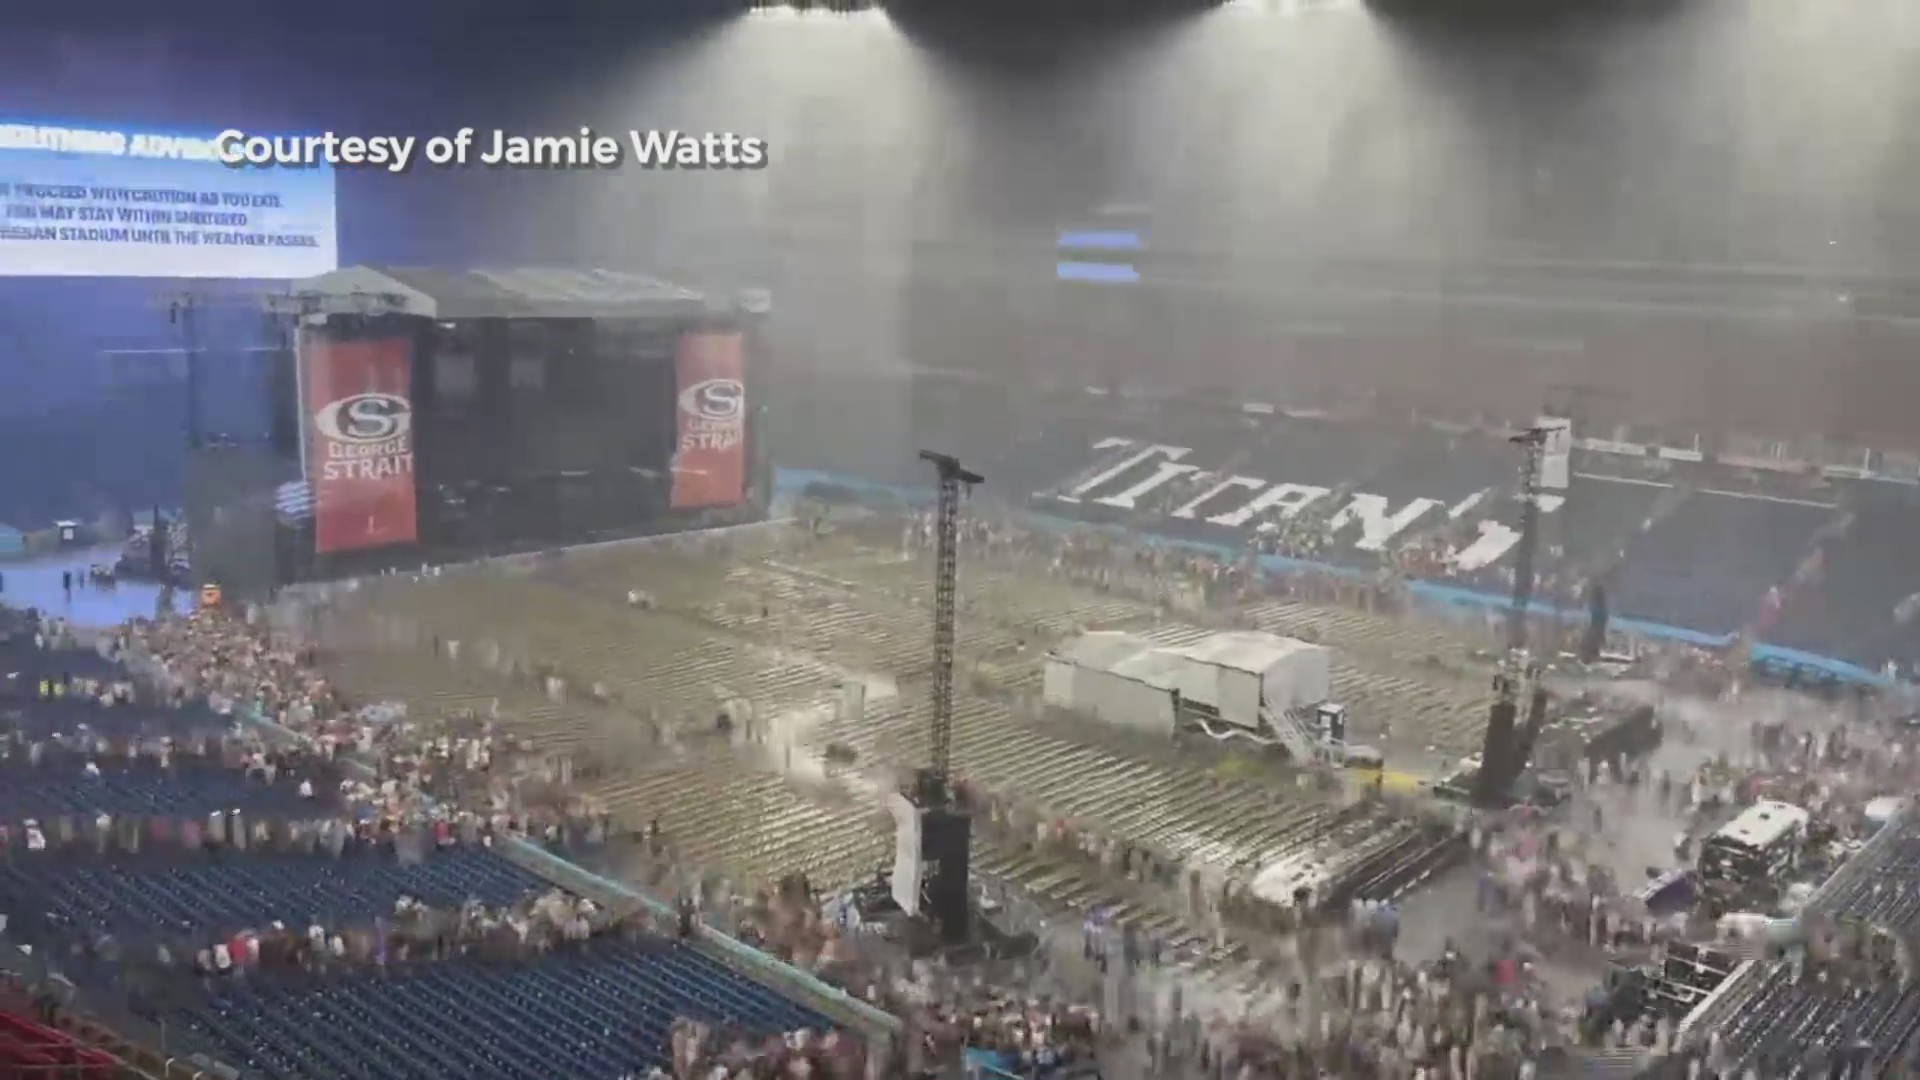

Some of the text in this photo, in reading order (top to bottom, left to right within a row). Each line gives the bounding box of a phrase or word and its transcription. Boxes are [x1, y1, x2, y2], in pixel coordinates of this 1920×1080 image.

[78, 206, 115, 221] STAY
[58, 226, 130, 243] STADIUM
[174, 230, 200, 246] THE
[328, 436, 408, 459] GEORGE
[323, 451, 414, 481] STRAIT
